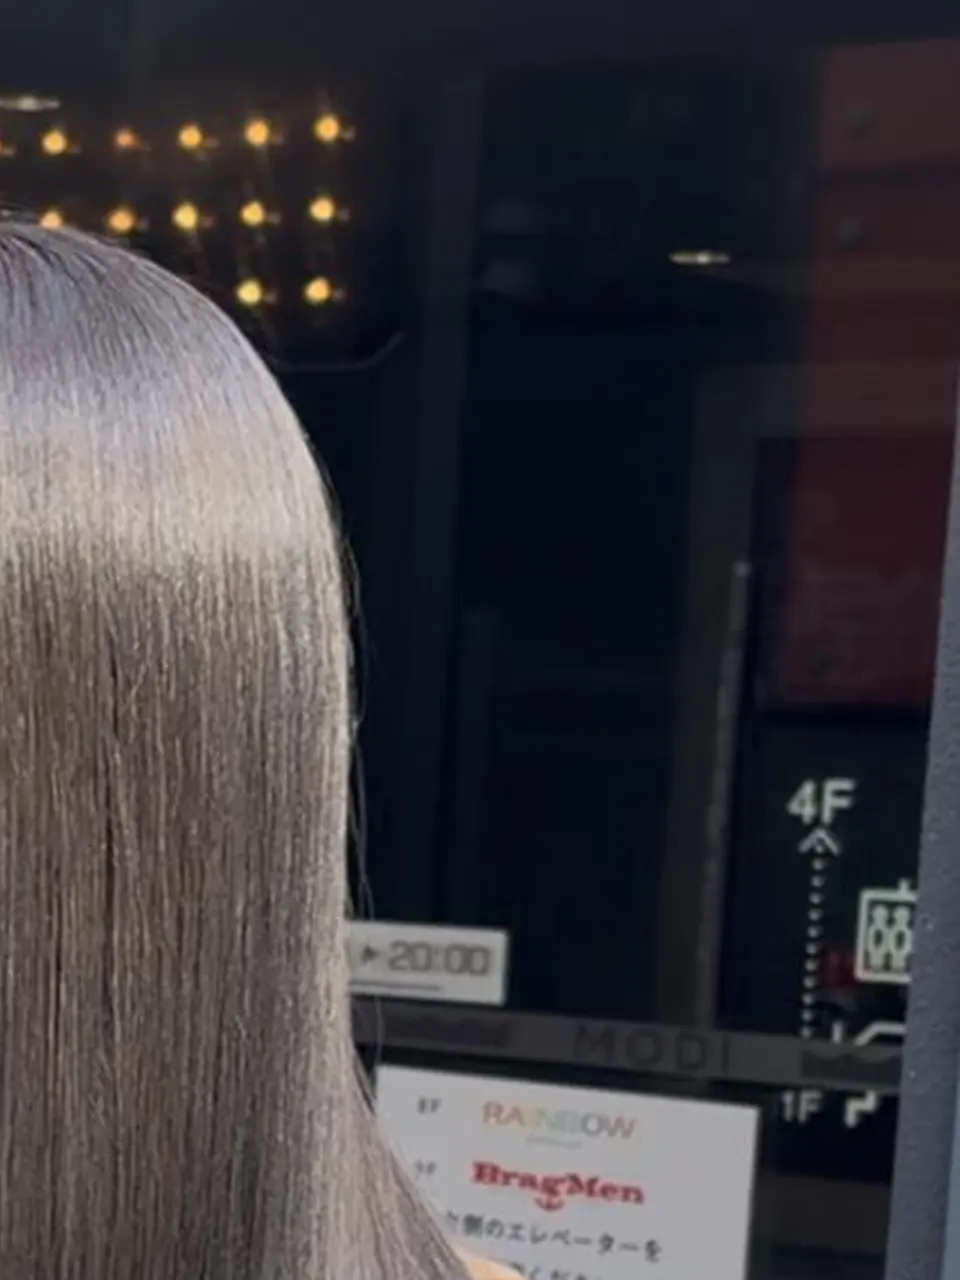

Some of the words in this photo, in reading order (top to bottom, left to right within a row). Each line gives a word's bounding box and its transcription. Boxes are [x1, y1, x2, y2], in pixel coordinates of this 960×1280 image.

[786, 777, 855, 825] 4F
[388, 941, 491, 976] 20:00
[574, 1023, 730, 1076] MODI
[483, 1101, 635, 1139] RAINBOW
[782, 1089, 822, 1124] 1F
[471, 1160, 644, 1210] BragMen
